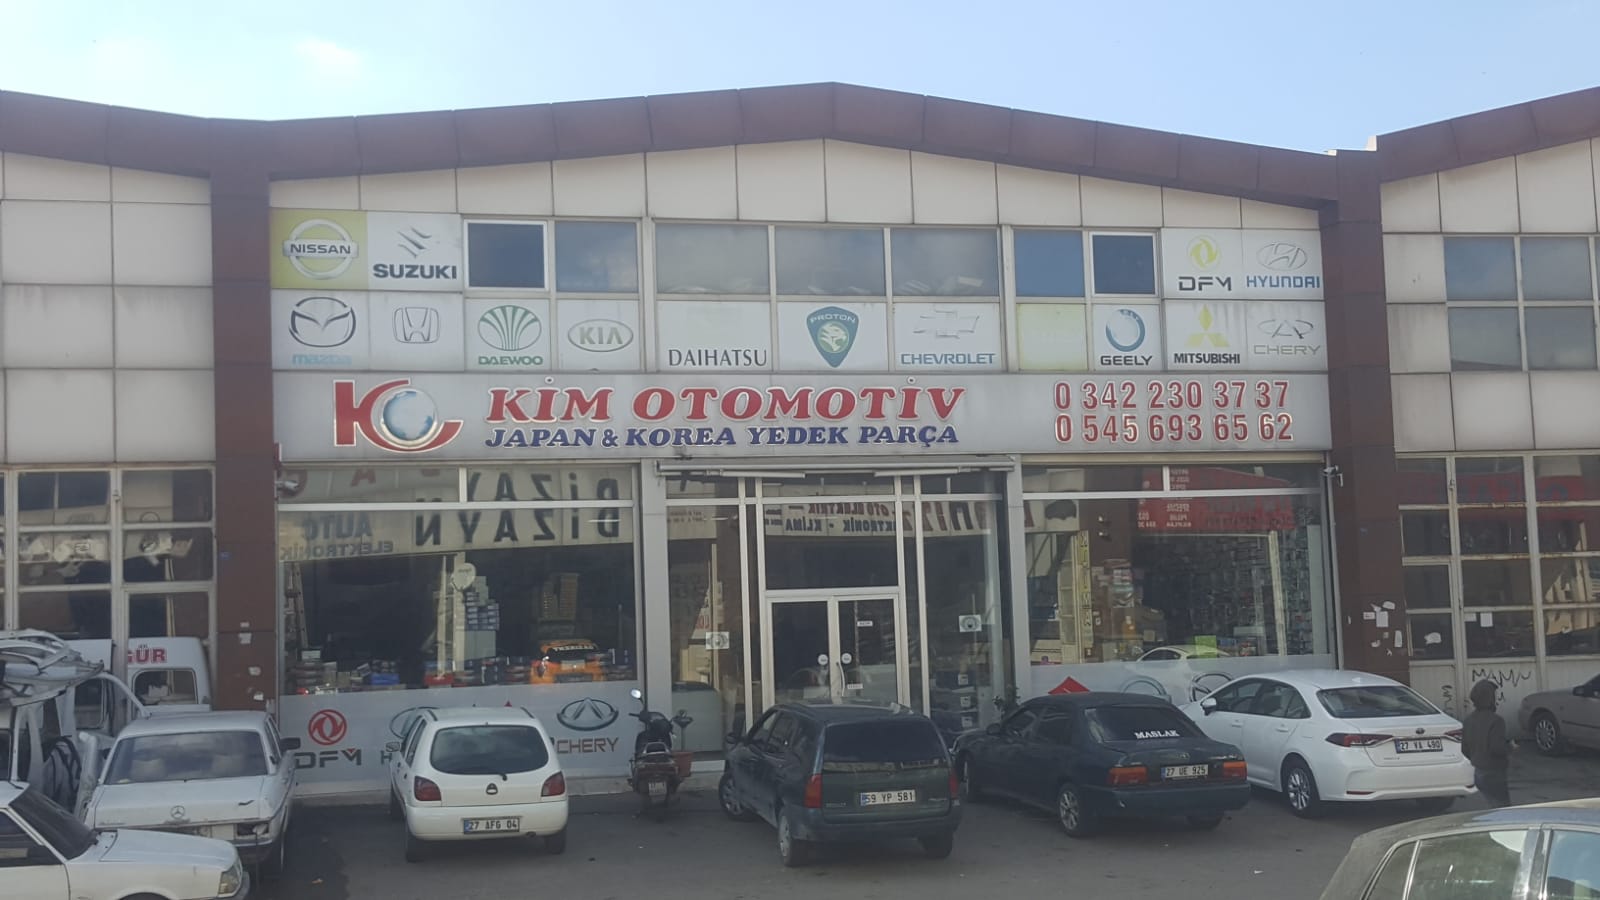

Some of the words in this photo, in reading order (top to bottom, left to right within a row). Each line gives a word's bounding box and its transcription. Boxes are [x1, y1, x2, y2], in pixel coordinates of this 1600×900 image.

[289, 243, 351, 255] NISSAN
[373, 263, 457, 280] SUZUKI
[1179, 275, 1232, 292] DFM
[1246, 274, 1321, 290] HYUNDAI
[809, 313, 856, 323] PROTON
[578, 327, 624, 346] KIA
[1253, 343, 1322, 356] CHERY
[478, 355, 544, 366] DAEWOO
[668, 349, 767, 367] DAIHATSU
[900, 352, 996, 365] CHEVROLET
[1100, 354, 1154, 366] GEELY
[1173, 352, 1241, 365] MITSUBISHI
[485, 376, 615, 423] KİM
[631, 376, 966, 422] OTOMOTİV
[1054, 381, 1072, 410] 0
[1080, 380, 1138, 410] 342
[1147, 380, 1203, 410] 230
[1213, 380, 1247, 409] 37
[1255, 379, 1290, 409] 37
[1054, 413, 1073, 444] 0
[1081, 413, 1139, 443] 545
[1148, 413, 1203, 443] 693
[1213, 413, 1249, 442] 65
[1258, 412, 1293, 442] 62
[485, 428, 597, 448] JAPAN
[601, 428, 620, 448] &
[625, 427, 737, 448] KOREA
[747, 426, 849, 446] YEDEK
[858, 425, 959, 449] PARÇA
[1134, 729, 1180, 740] MASLAK
[556, 736, 619, 754] CHERY
[294, 747, 362, 769] DFM
[1166, 767, 1175, 776] 27
[897, 791, 913, 801] 581
[468, 821, 480, 830] 27
